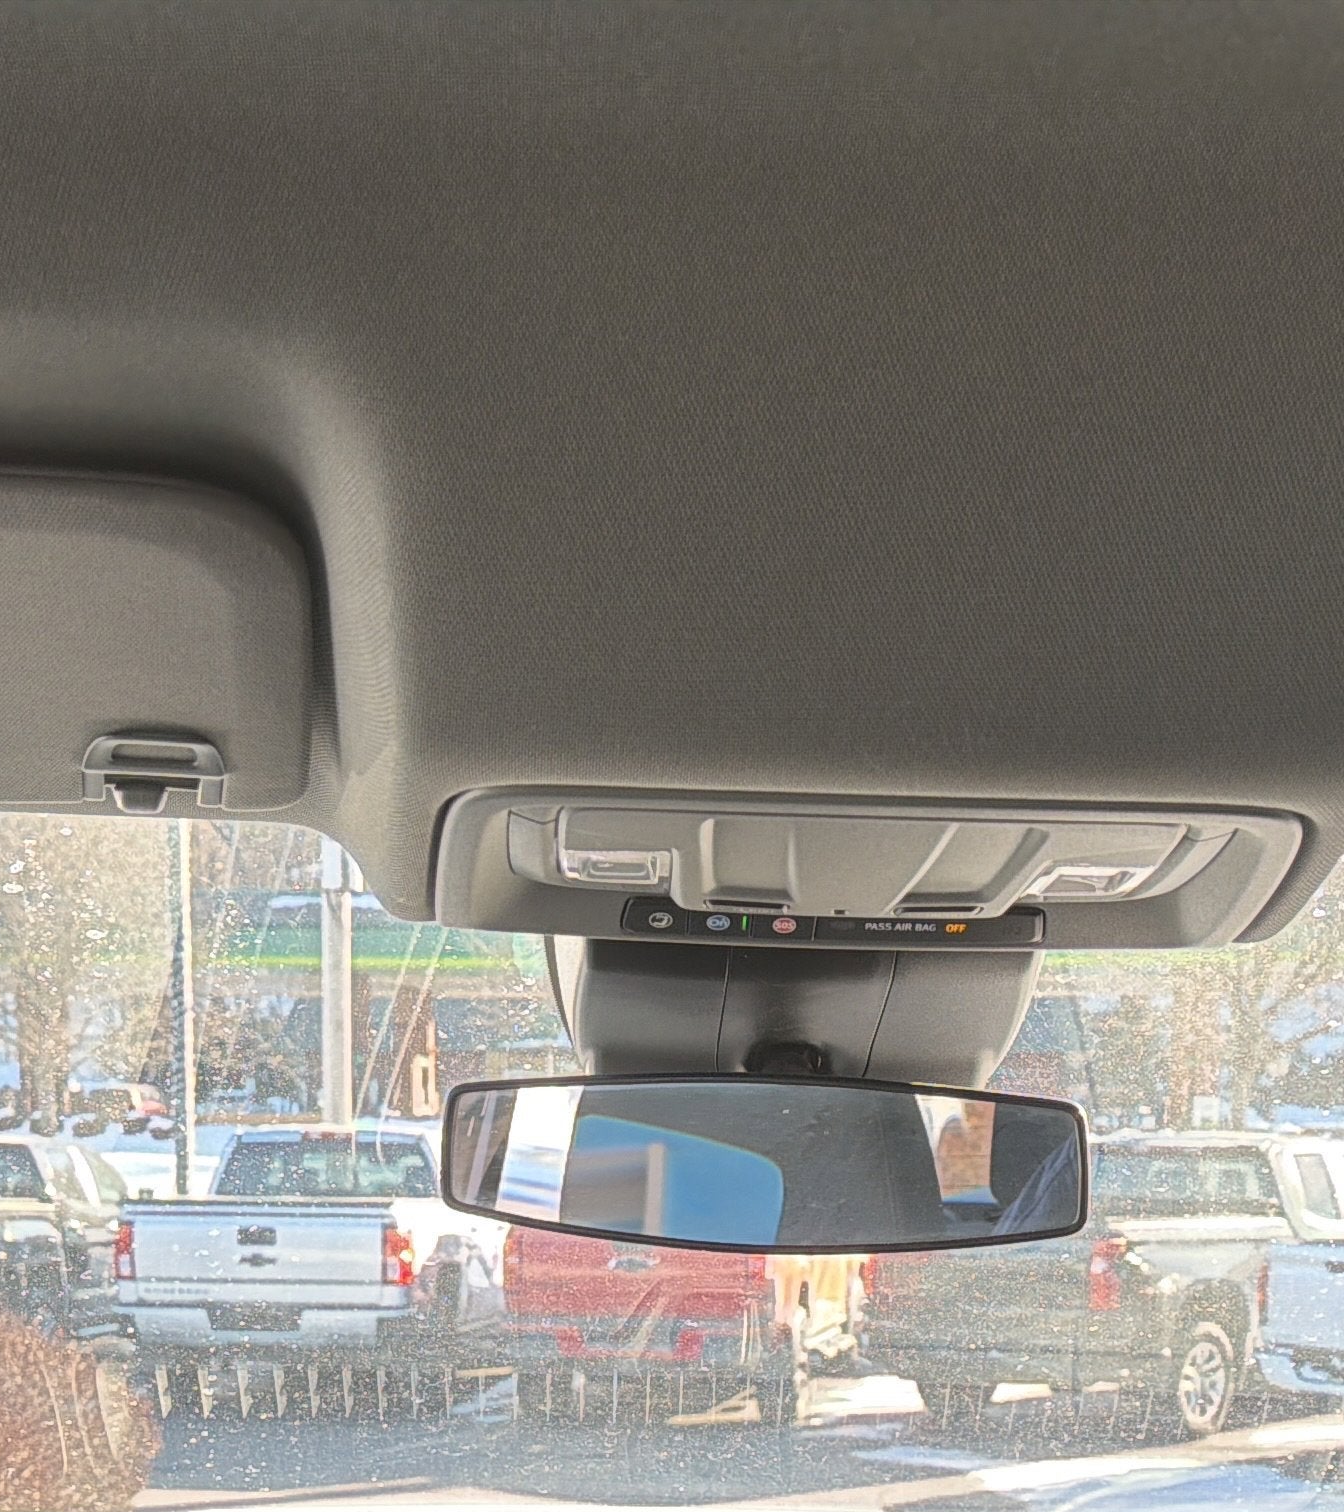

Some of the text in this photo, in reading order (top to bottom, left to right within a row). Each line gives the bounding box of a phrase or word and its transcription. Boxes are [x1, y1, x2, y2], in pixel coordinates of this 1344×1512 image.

[774, 920, 794, 931] SOS
[864, 921, 966, 934] PASS AIR BAG OFF
